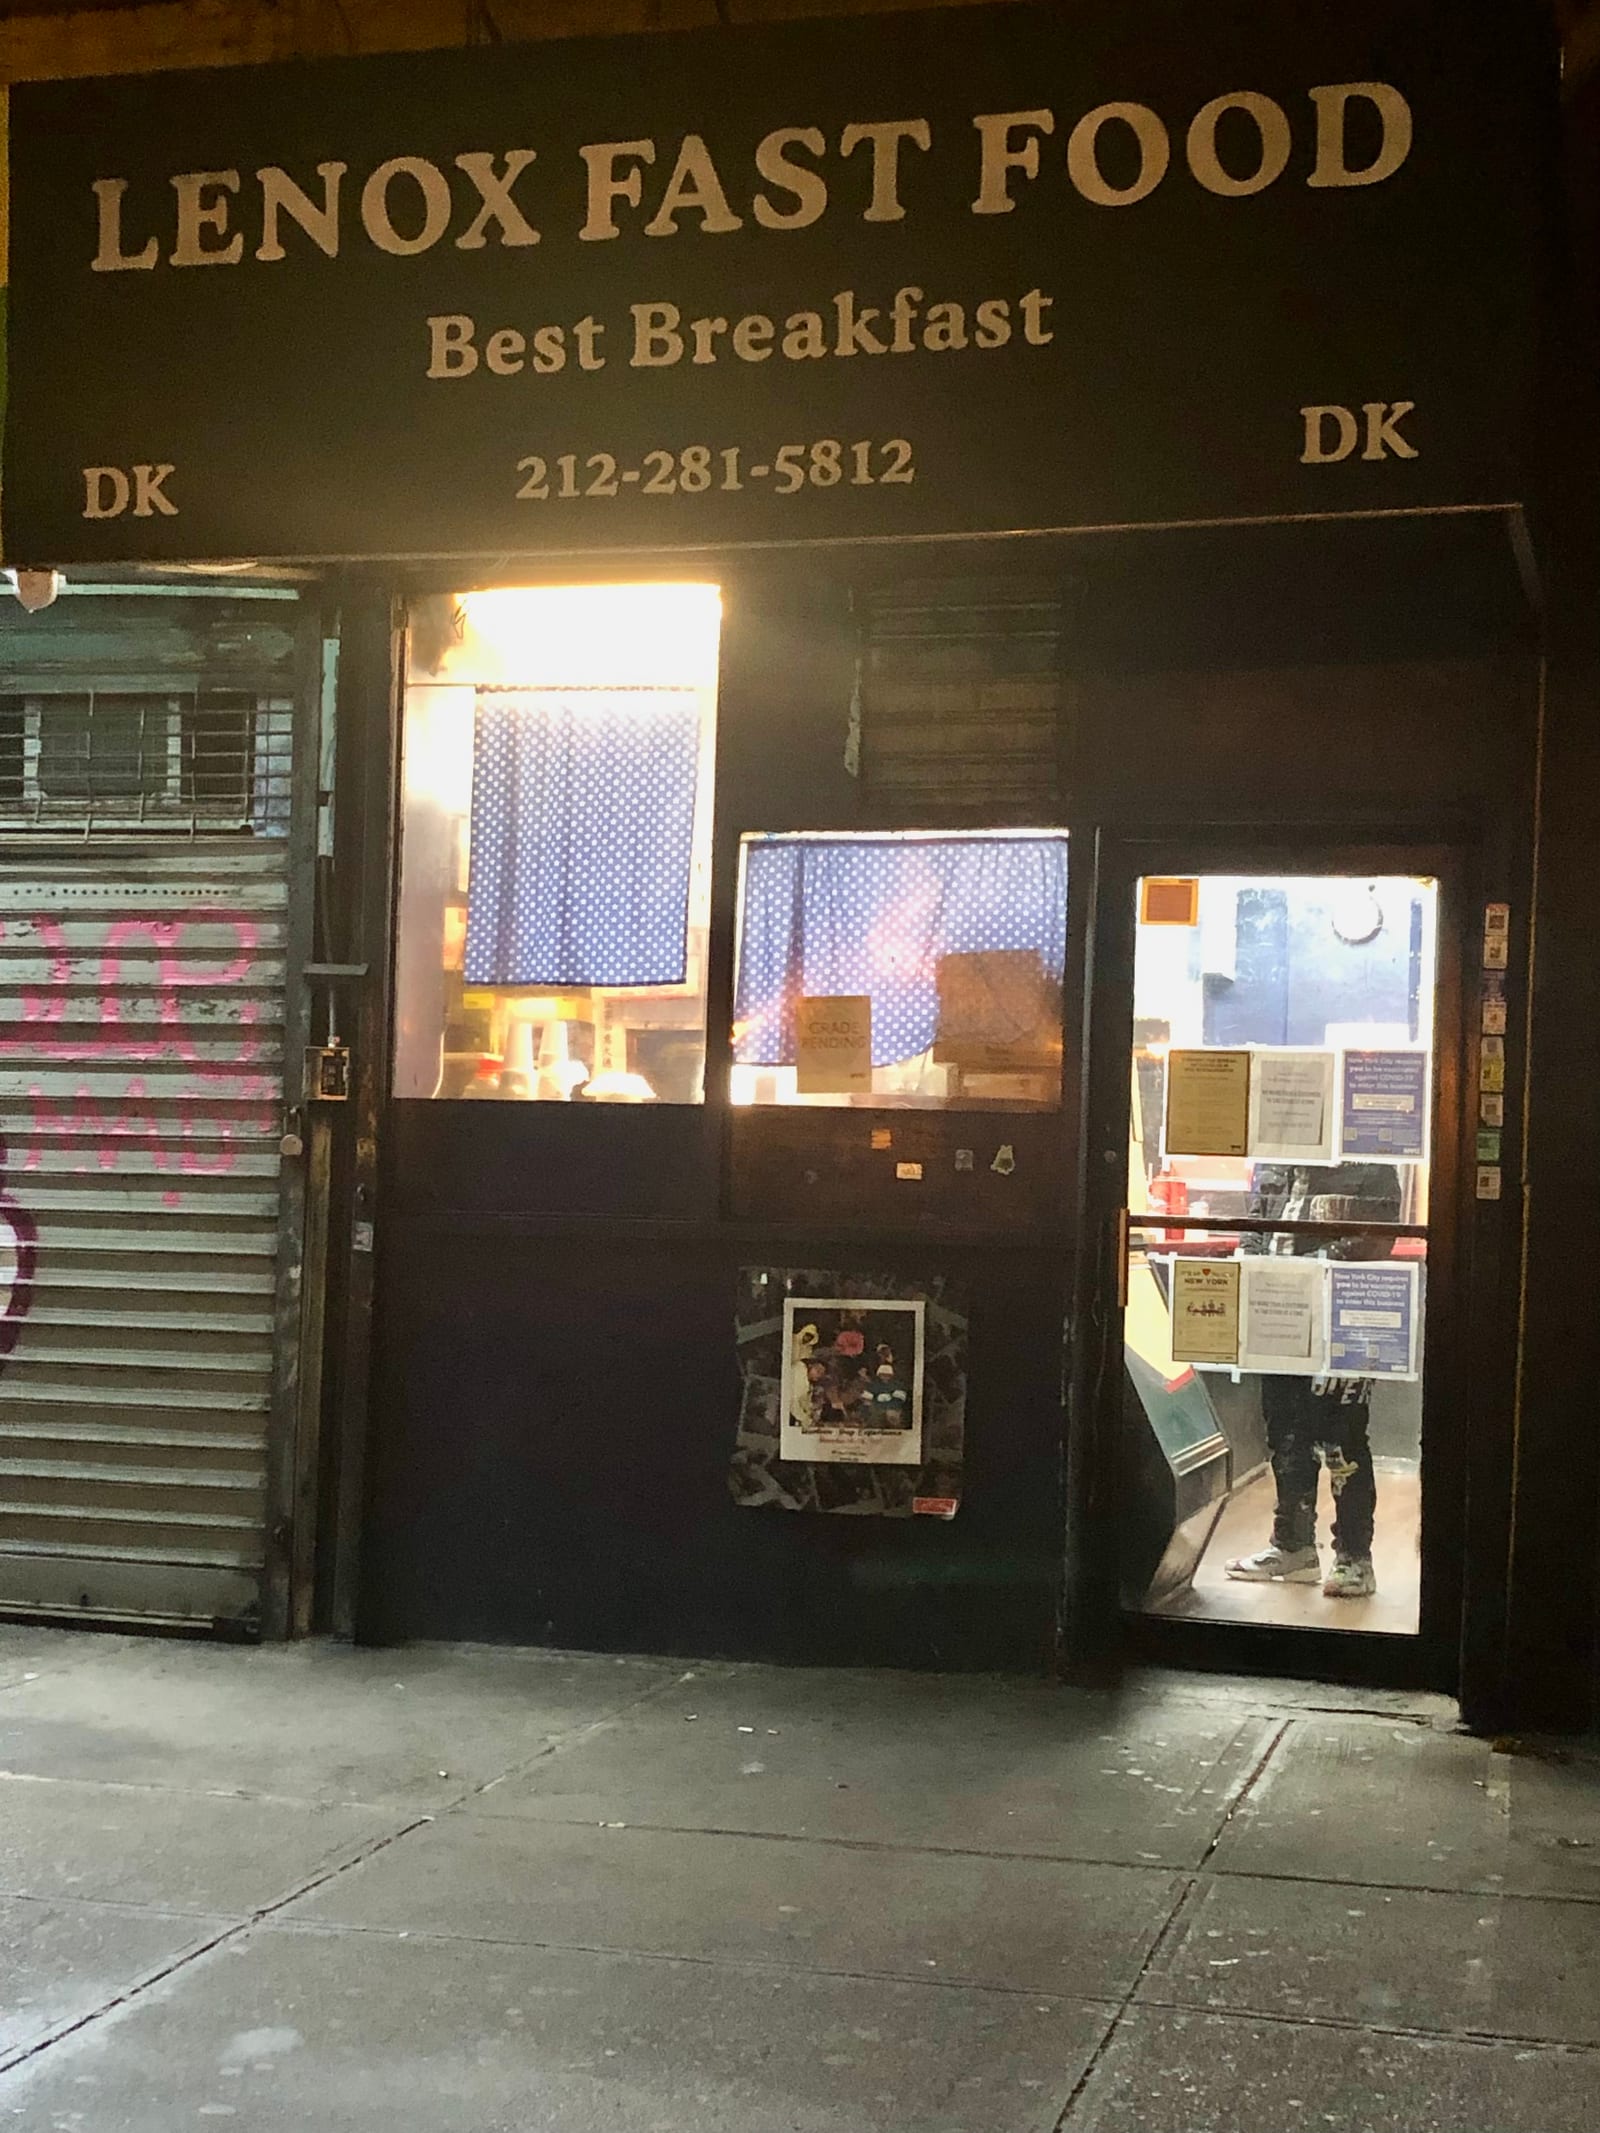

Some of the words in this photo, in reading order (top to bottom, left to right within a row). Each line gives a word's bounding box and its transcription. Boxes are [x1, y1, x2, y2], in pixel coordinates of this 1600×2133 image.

[91, 149, 542, 272] LENOX
[578, 119, 931, 242] FAST
[971, 82, 1412, 214] FOOD
[426, 315, 606, 379] Best
[628, 287, 1053, 368] Breakfast
[1300, 401, 1419, 464] DK
[83, 464, 179, 519] DK
[515, 439, 914, 501] 212-281-5812
[801, 1036, 866, 1049] PENDING
[808, 1022, 860, 1035] GRADE
